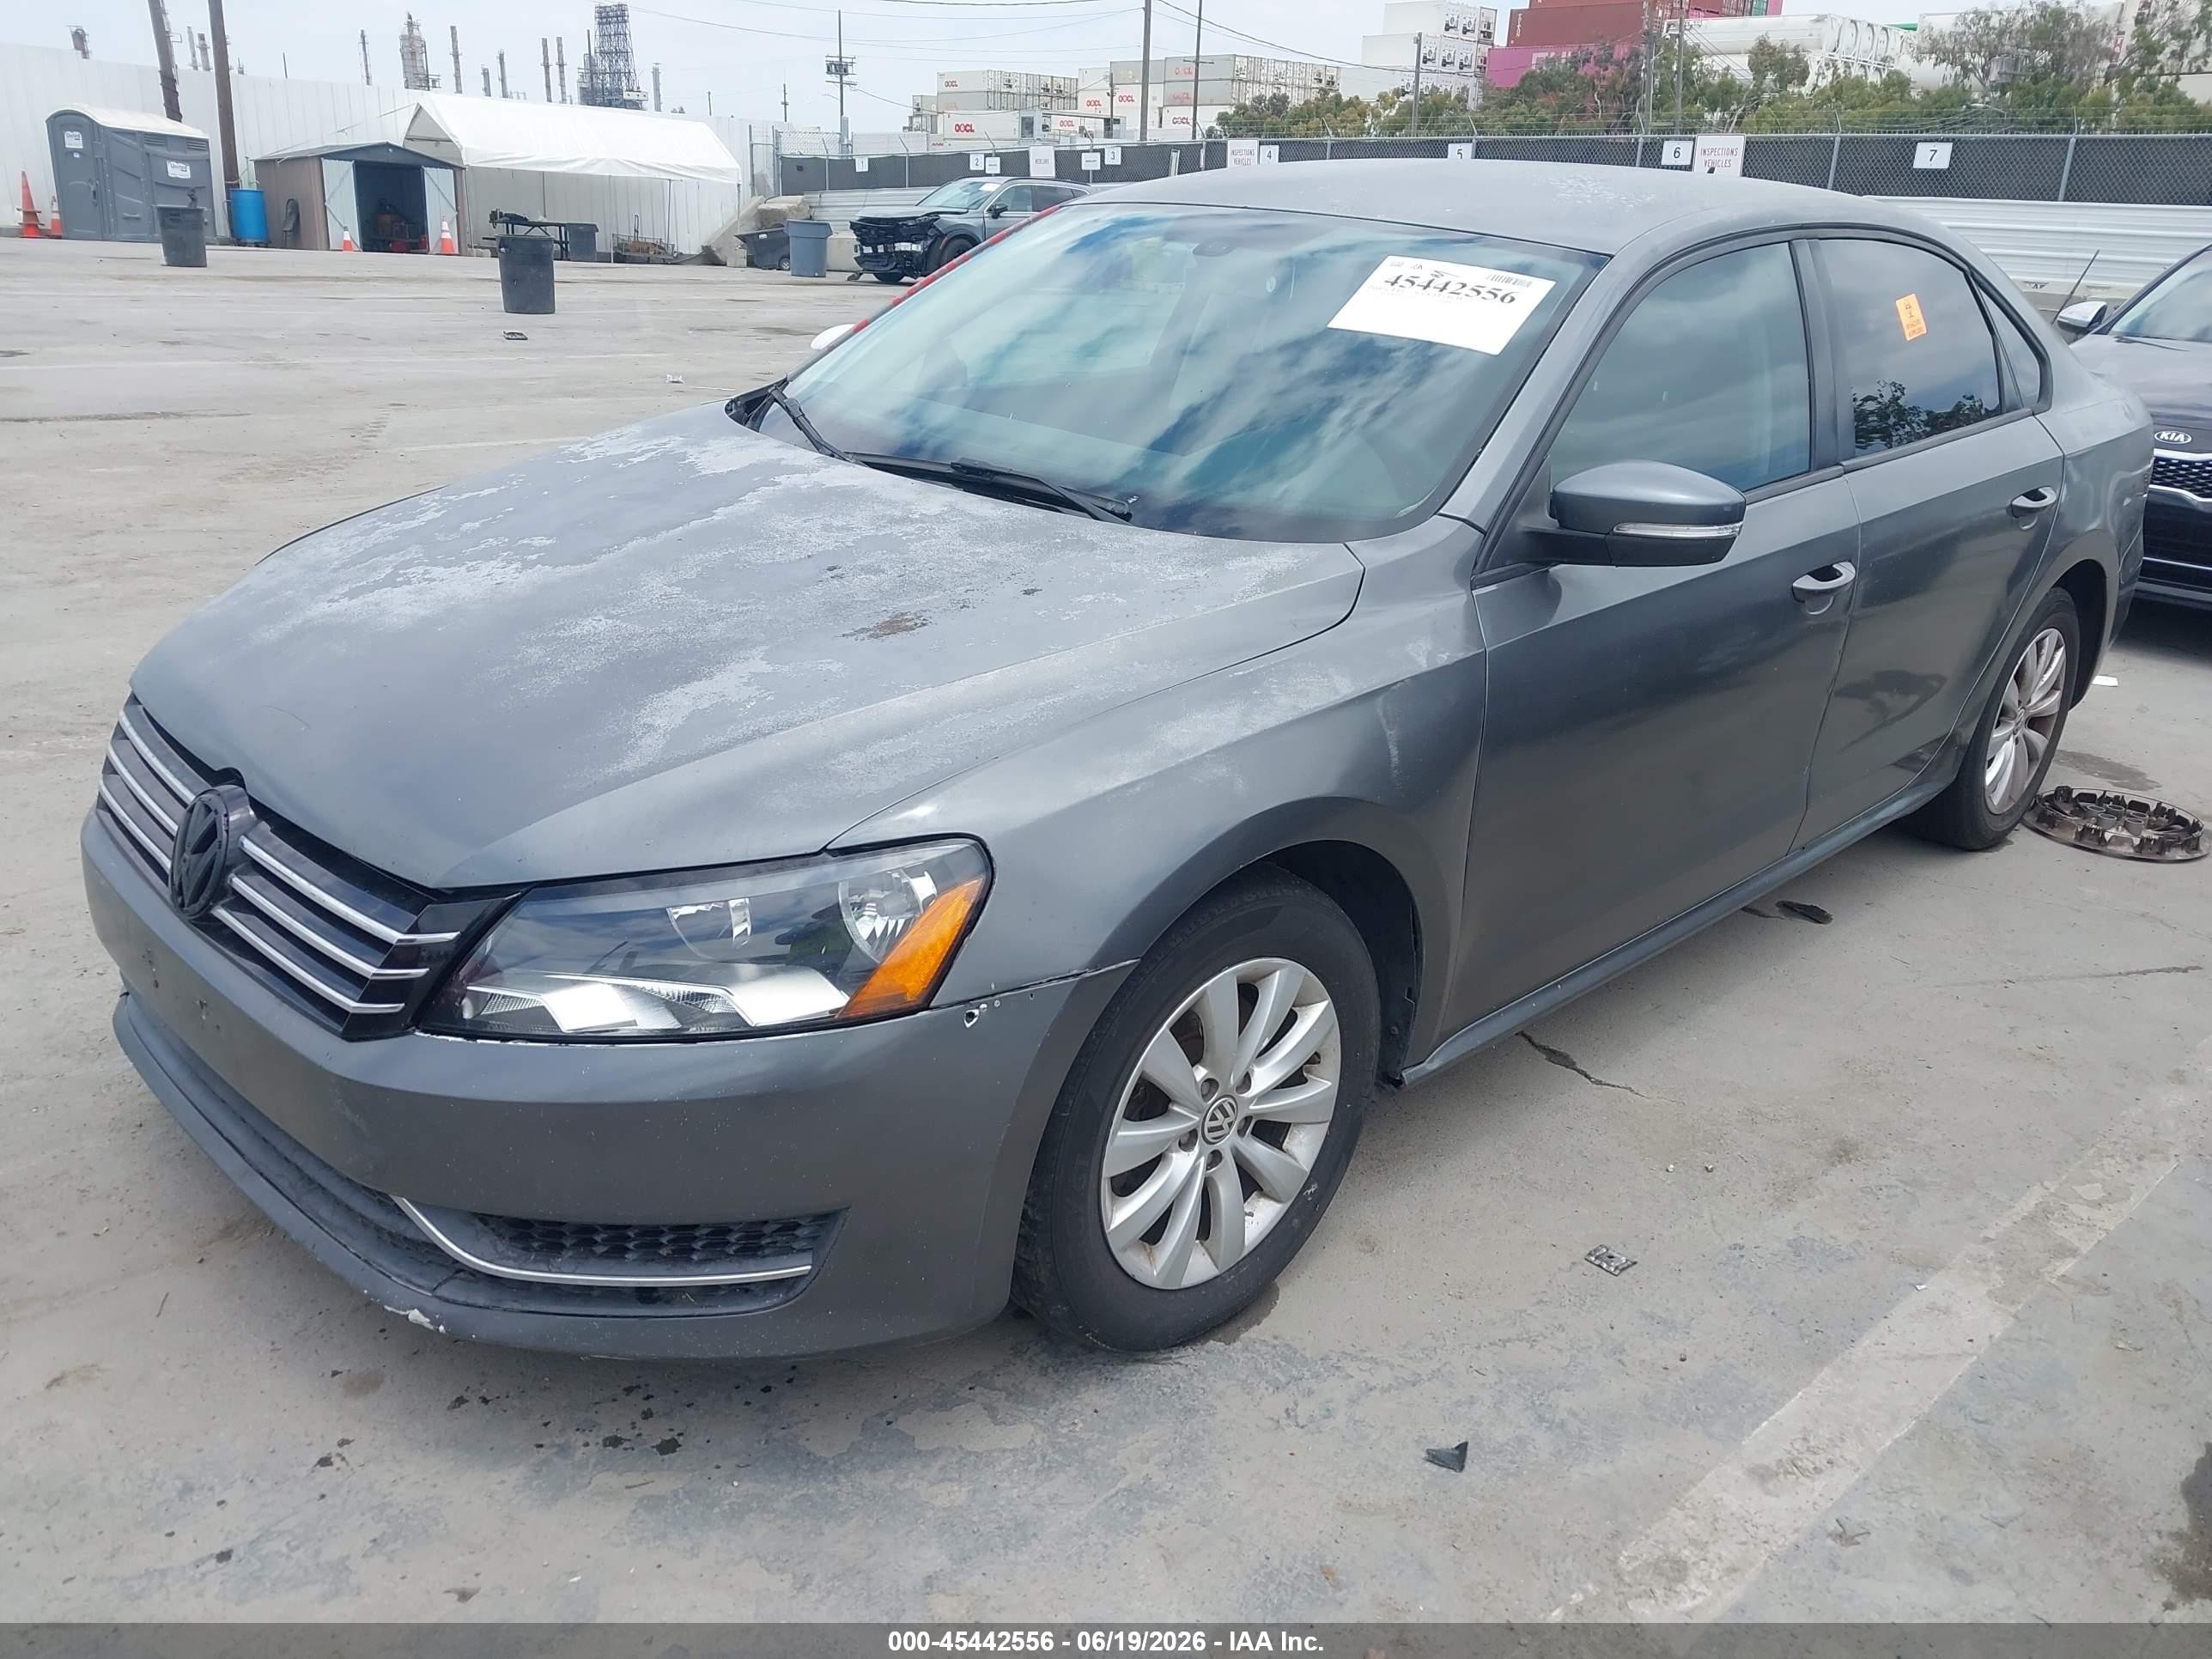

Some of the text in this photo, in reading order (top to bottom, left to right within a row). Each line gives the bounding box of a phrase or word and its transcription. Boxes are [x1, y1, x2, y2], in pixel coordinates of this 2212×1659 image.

[1118, 94, 1135, 103] OOCL
[1059, 118, 1075, 127] OOCL
[954, 123, 975, 133] OOCL
[1110, 150, 1115, 161] 3
[1267, 150, 1272, 160] 4
[1456, 149, 1463, 160] 5
[1673, 147, 1681, 159] 6
[1701, 148, 1738, 157] INSPECTIONS
[1929, 149, 1938, 162] 7
[975, 157, 980, 167] 2
[1704, 160, 1732, 168] VEHICLES
[1384, 274, 1519, 304] 45442556
[2160, 431, 2185, 442] KIA
